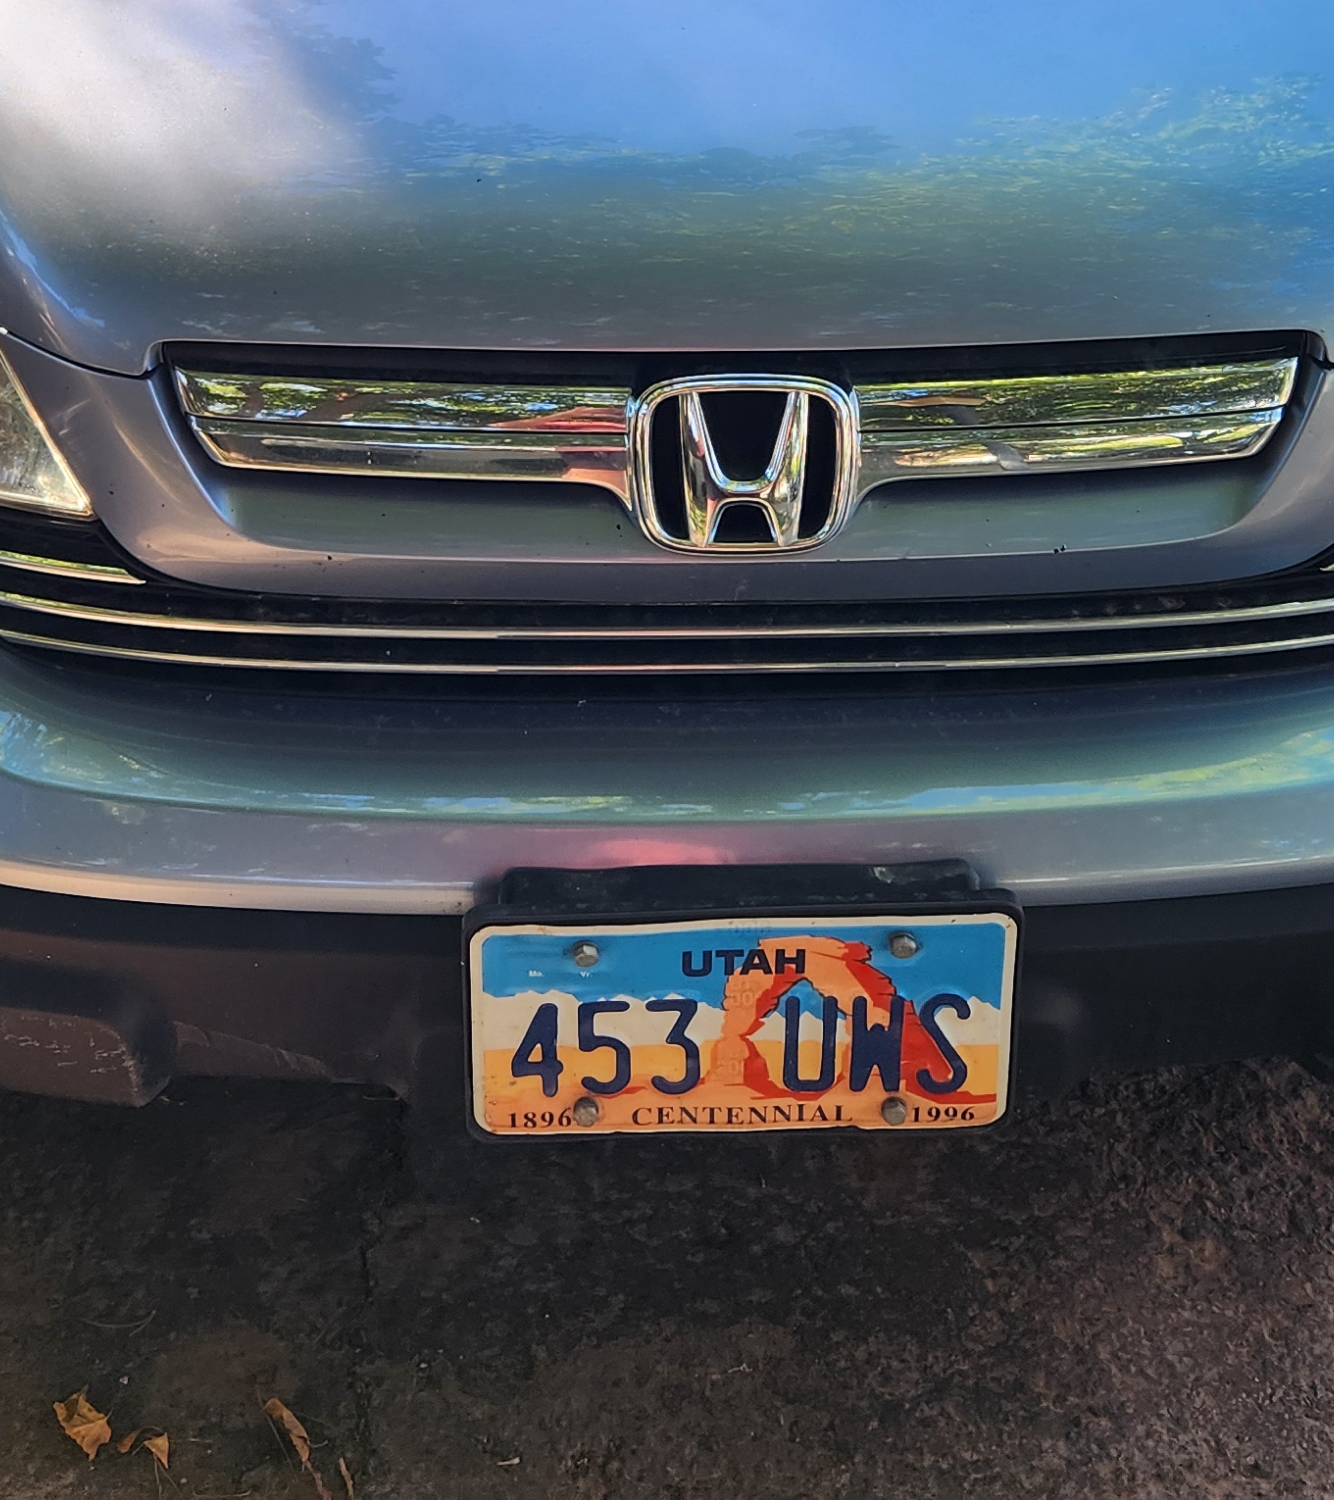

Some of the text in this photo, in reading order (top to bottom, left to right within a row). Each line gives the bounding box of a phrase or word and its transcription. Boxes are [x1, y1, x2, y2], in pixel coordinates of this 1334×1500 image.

[681, 949, 806, 978] UTAH
[511, 993, 971, 1097] 453 UWS
[508, 1104, 976, 1129] 1896 CENTENNIAL 1996
